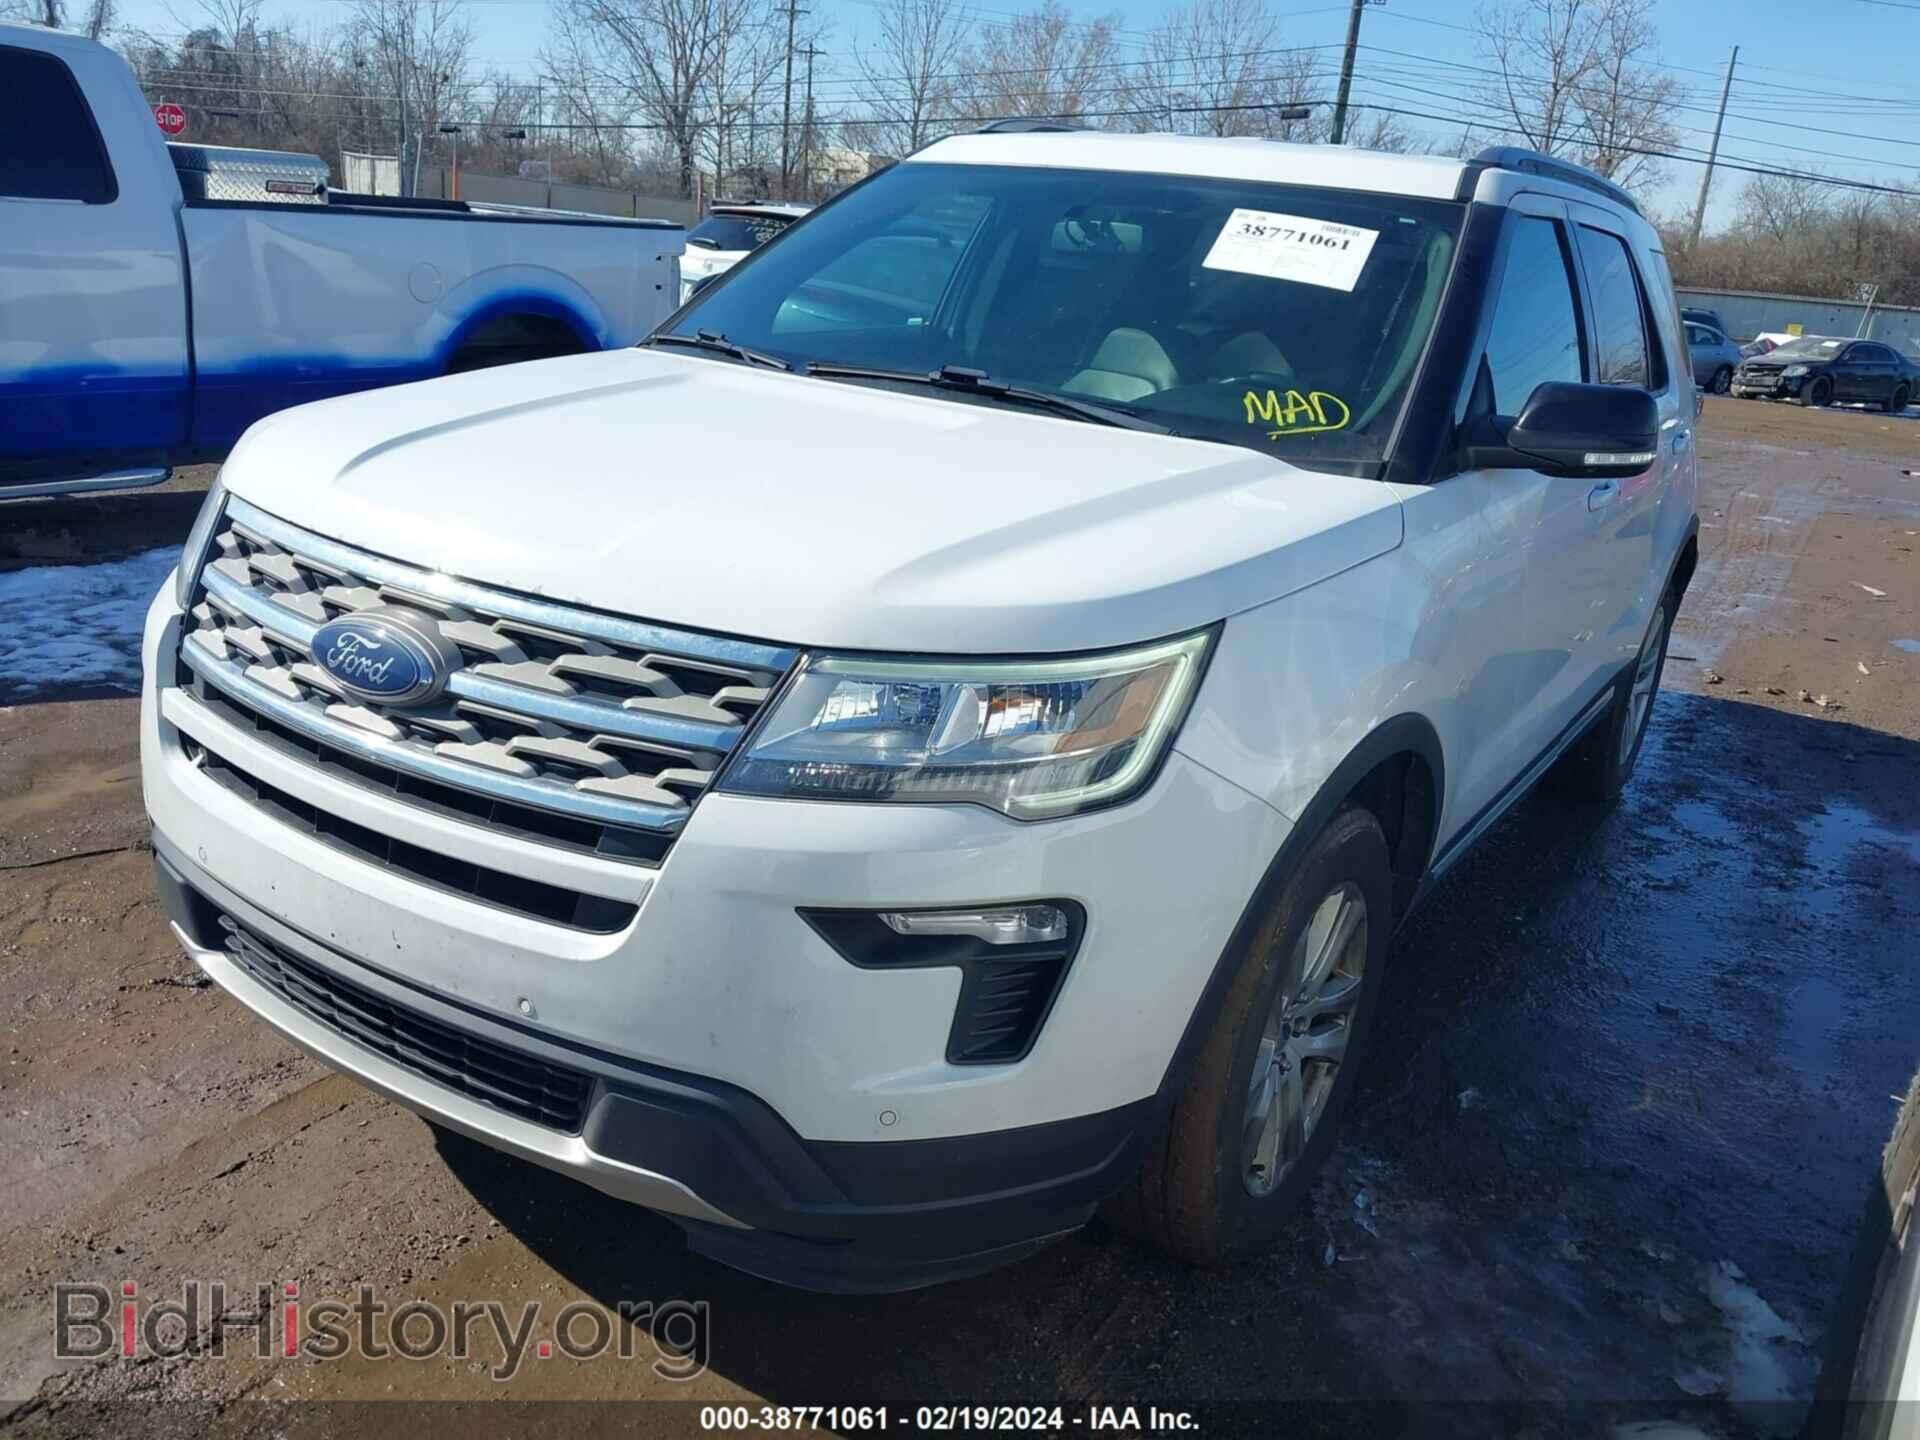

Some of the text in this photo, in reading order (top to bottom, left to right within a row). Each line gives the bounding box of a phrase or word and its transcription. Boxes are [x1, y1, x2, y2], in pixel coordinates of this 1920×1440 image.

[158, 111, 184, 127] STOP
[1237, 223, 1351, 251] 38771061
[1243, 389, 1350, 432] MAD
[327, 631, 394, 685] Ford
